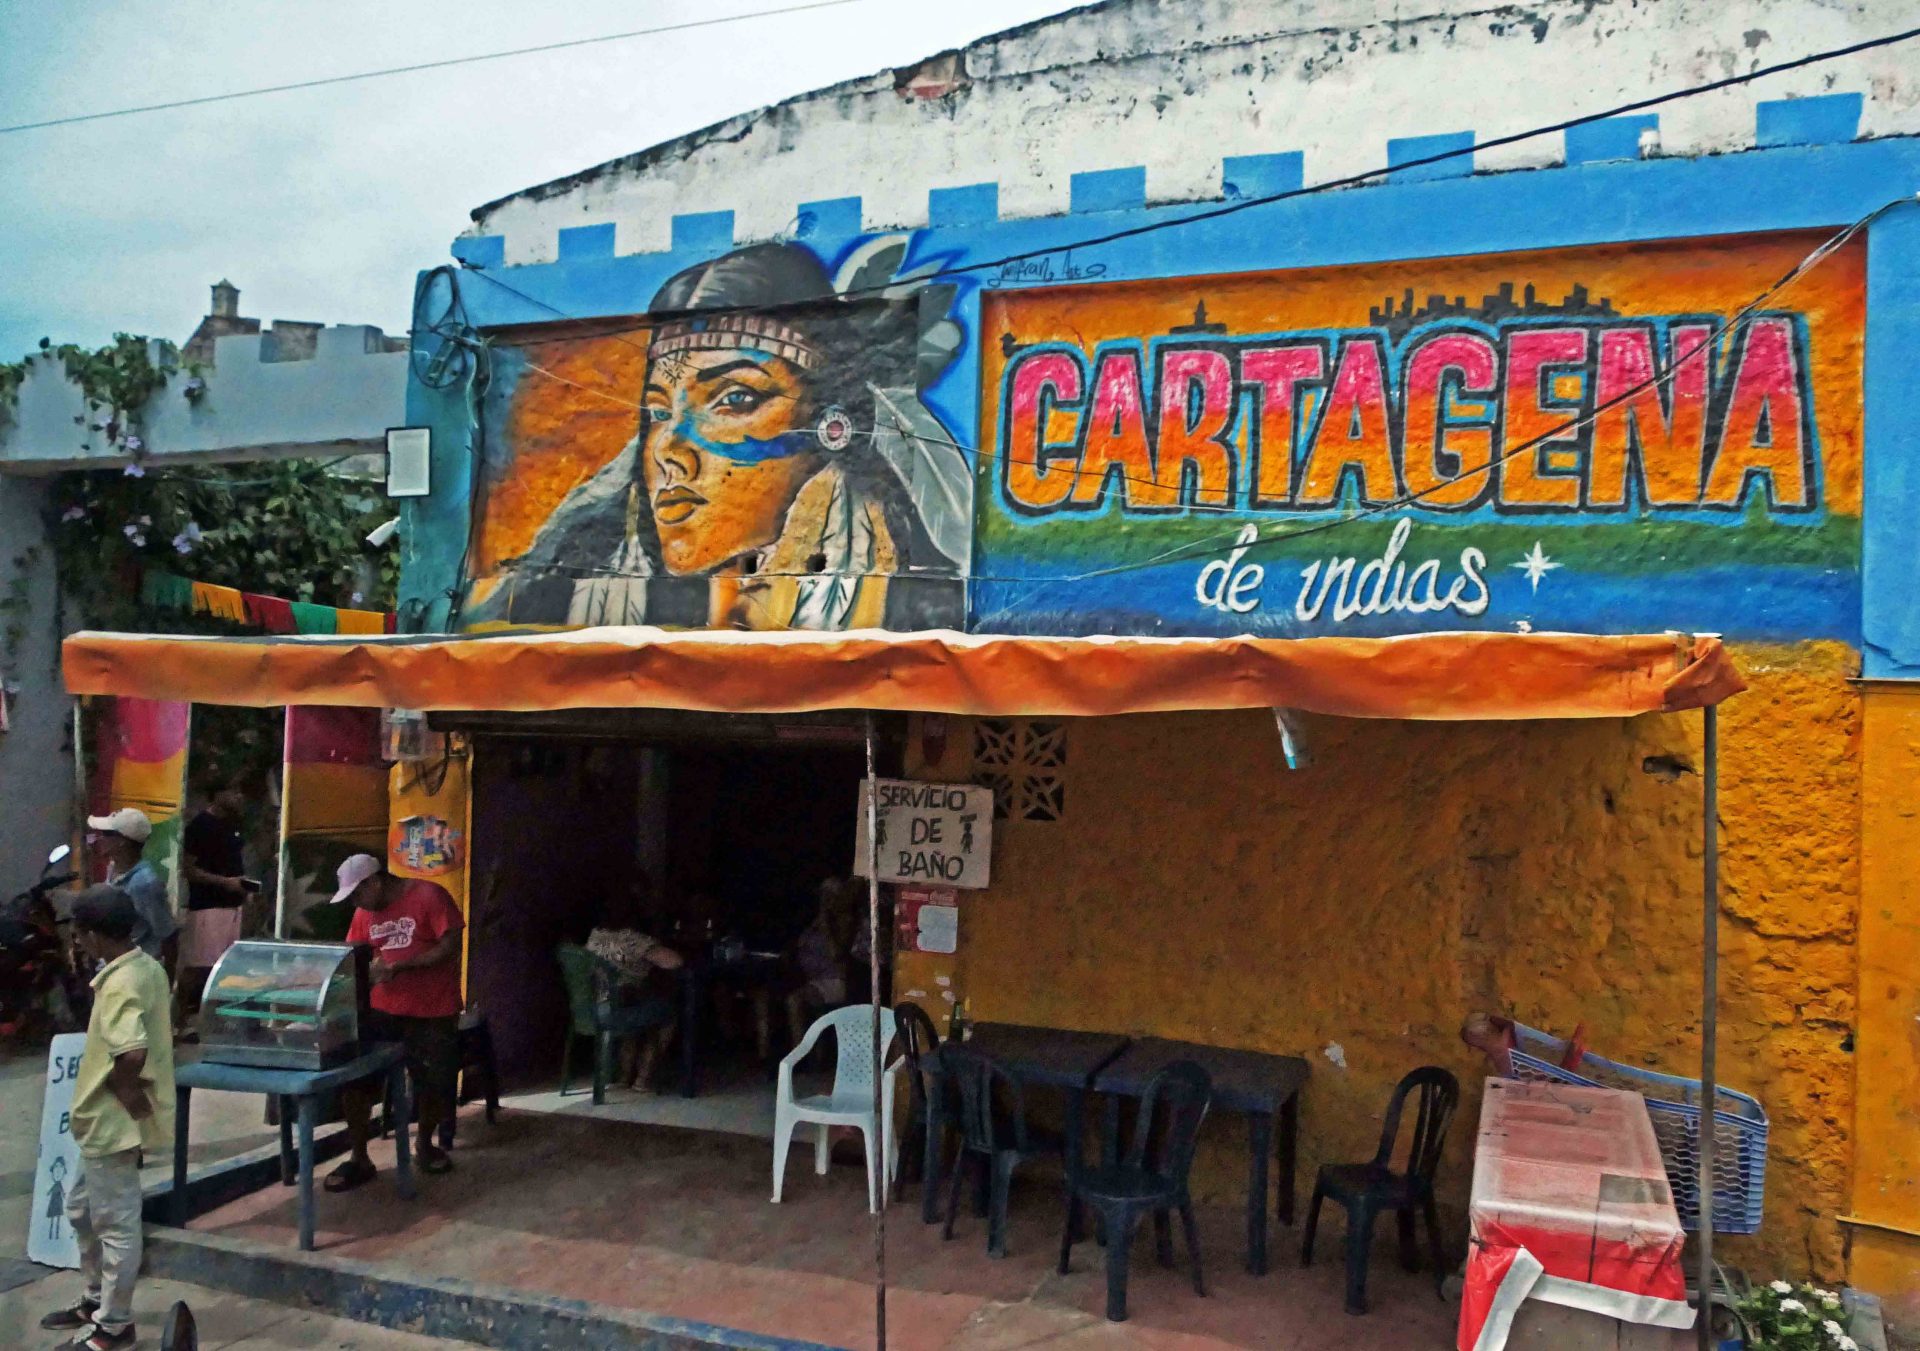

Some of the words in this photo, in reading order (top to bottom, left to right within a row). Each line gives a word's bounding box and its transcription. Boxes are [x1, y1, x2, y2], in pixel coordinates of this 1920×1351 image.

[1002, 314, 1817, 515] CARTAGENA
[1194, 522, 1264, 612] de
[1296, 517, 1490, 621] indias
[911, 817, 942, 845] DE
[896, 851, 964, 881] BAÑO
